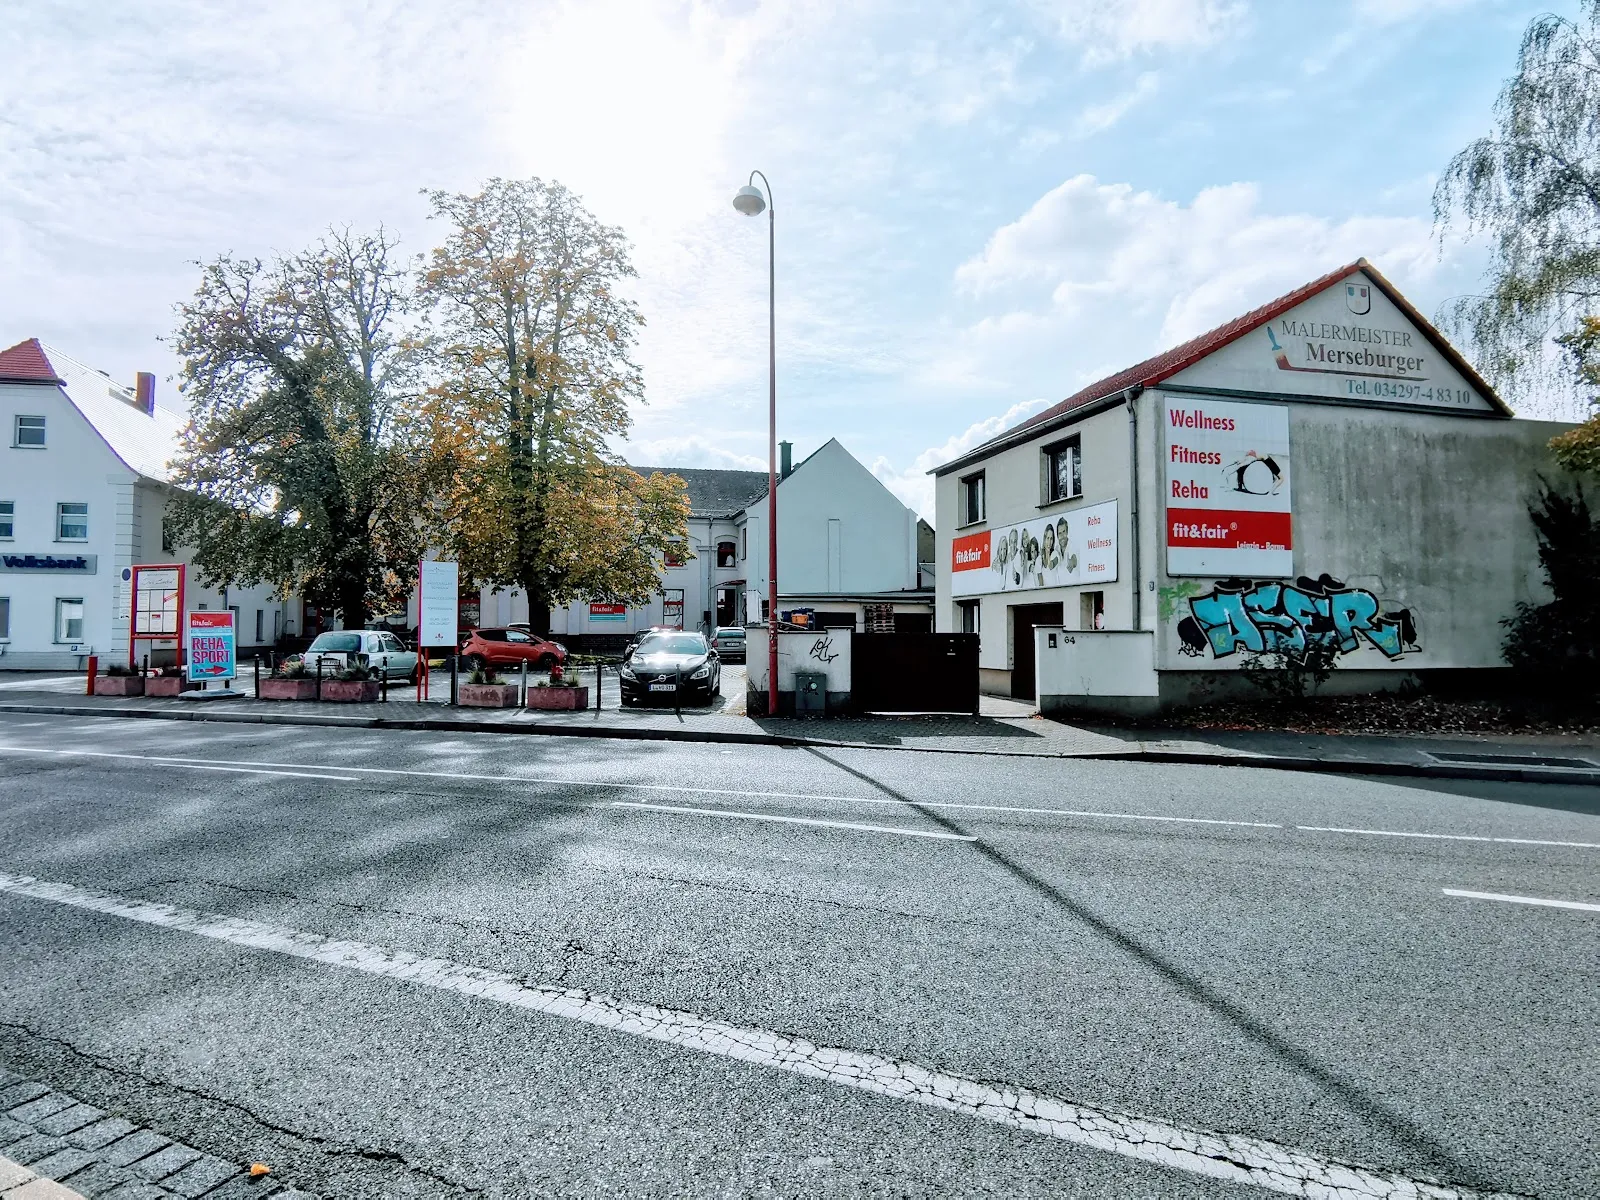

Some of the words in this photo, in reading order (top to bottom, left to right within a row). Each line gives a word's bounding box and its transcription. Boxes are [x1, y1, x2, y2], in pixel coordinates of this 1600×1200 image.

[1282, 320, 1413, 347] MALERMEISTER
[1306, 342, 1424, 374] Merseburger
[1345, 379, 1370, 396] Tel.
[1374, 381, 1433, 401] 034297-4
[1436, 388, 1451, 402] 83
[1456, 390, 1470, 404] 10
[1169, 409, 1235, 431] Wellness
[1171, 444, 1221, 465] Fitness
[1172, 479, 1208, 499] Reha
[1087, 515, 1101, 527] Reha
[1087, 538, 1112, 550] Wellness
[2, 555, 87, 569] Volksbank
[1087, 563, 1106, 573] Fitness
[192, 637, 230, 650] REHA-
[1064, 635, 1076, 645] 64
[193, 650, 230, 664] SPORT
